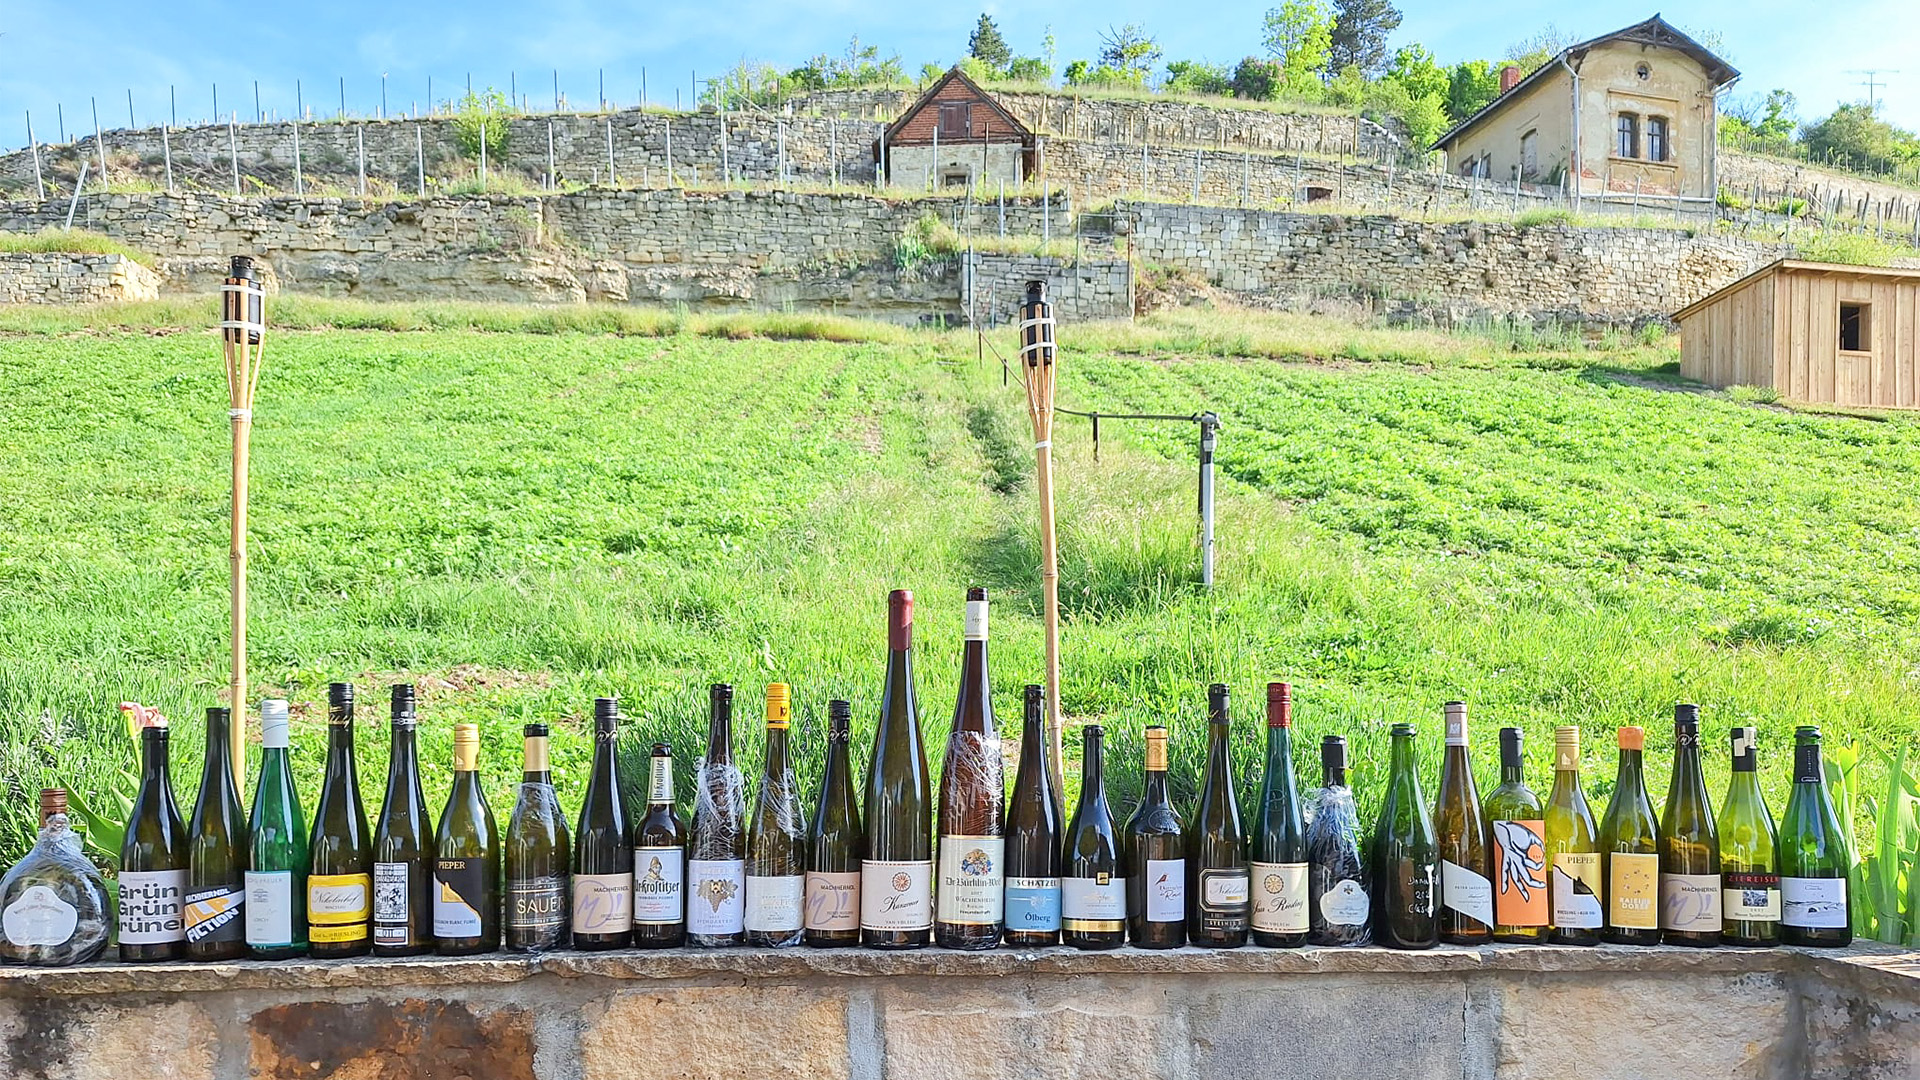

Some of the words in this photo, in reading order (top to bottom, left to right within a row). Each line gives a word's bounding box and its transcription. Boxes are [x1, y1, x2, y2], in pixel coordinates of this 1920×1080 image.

[118, 883, 179, 899] Grün
[118, 900, 179, 916] Grün
[1024, 912, 1051, 923] Ölberg
